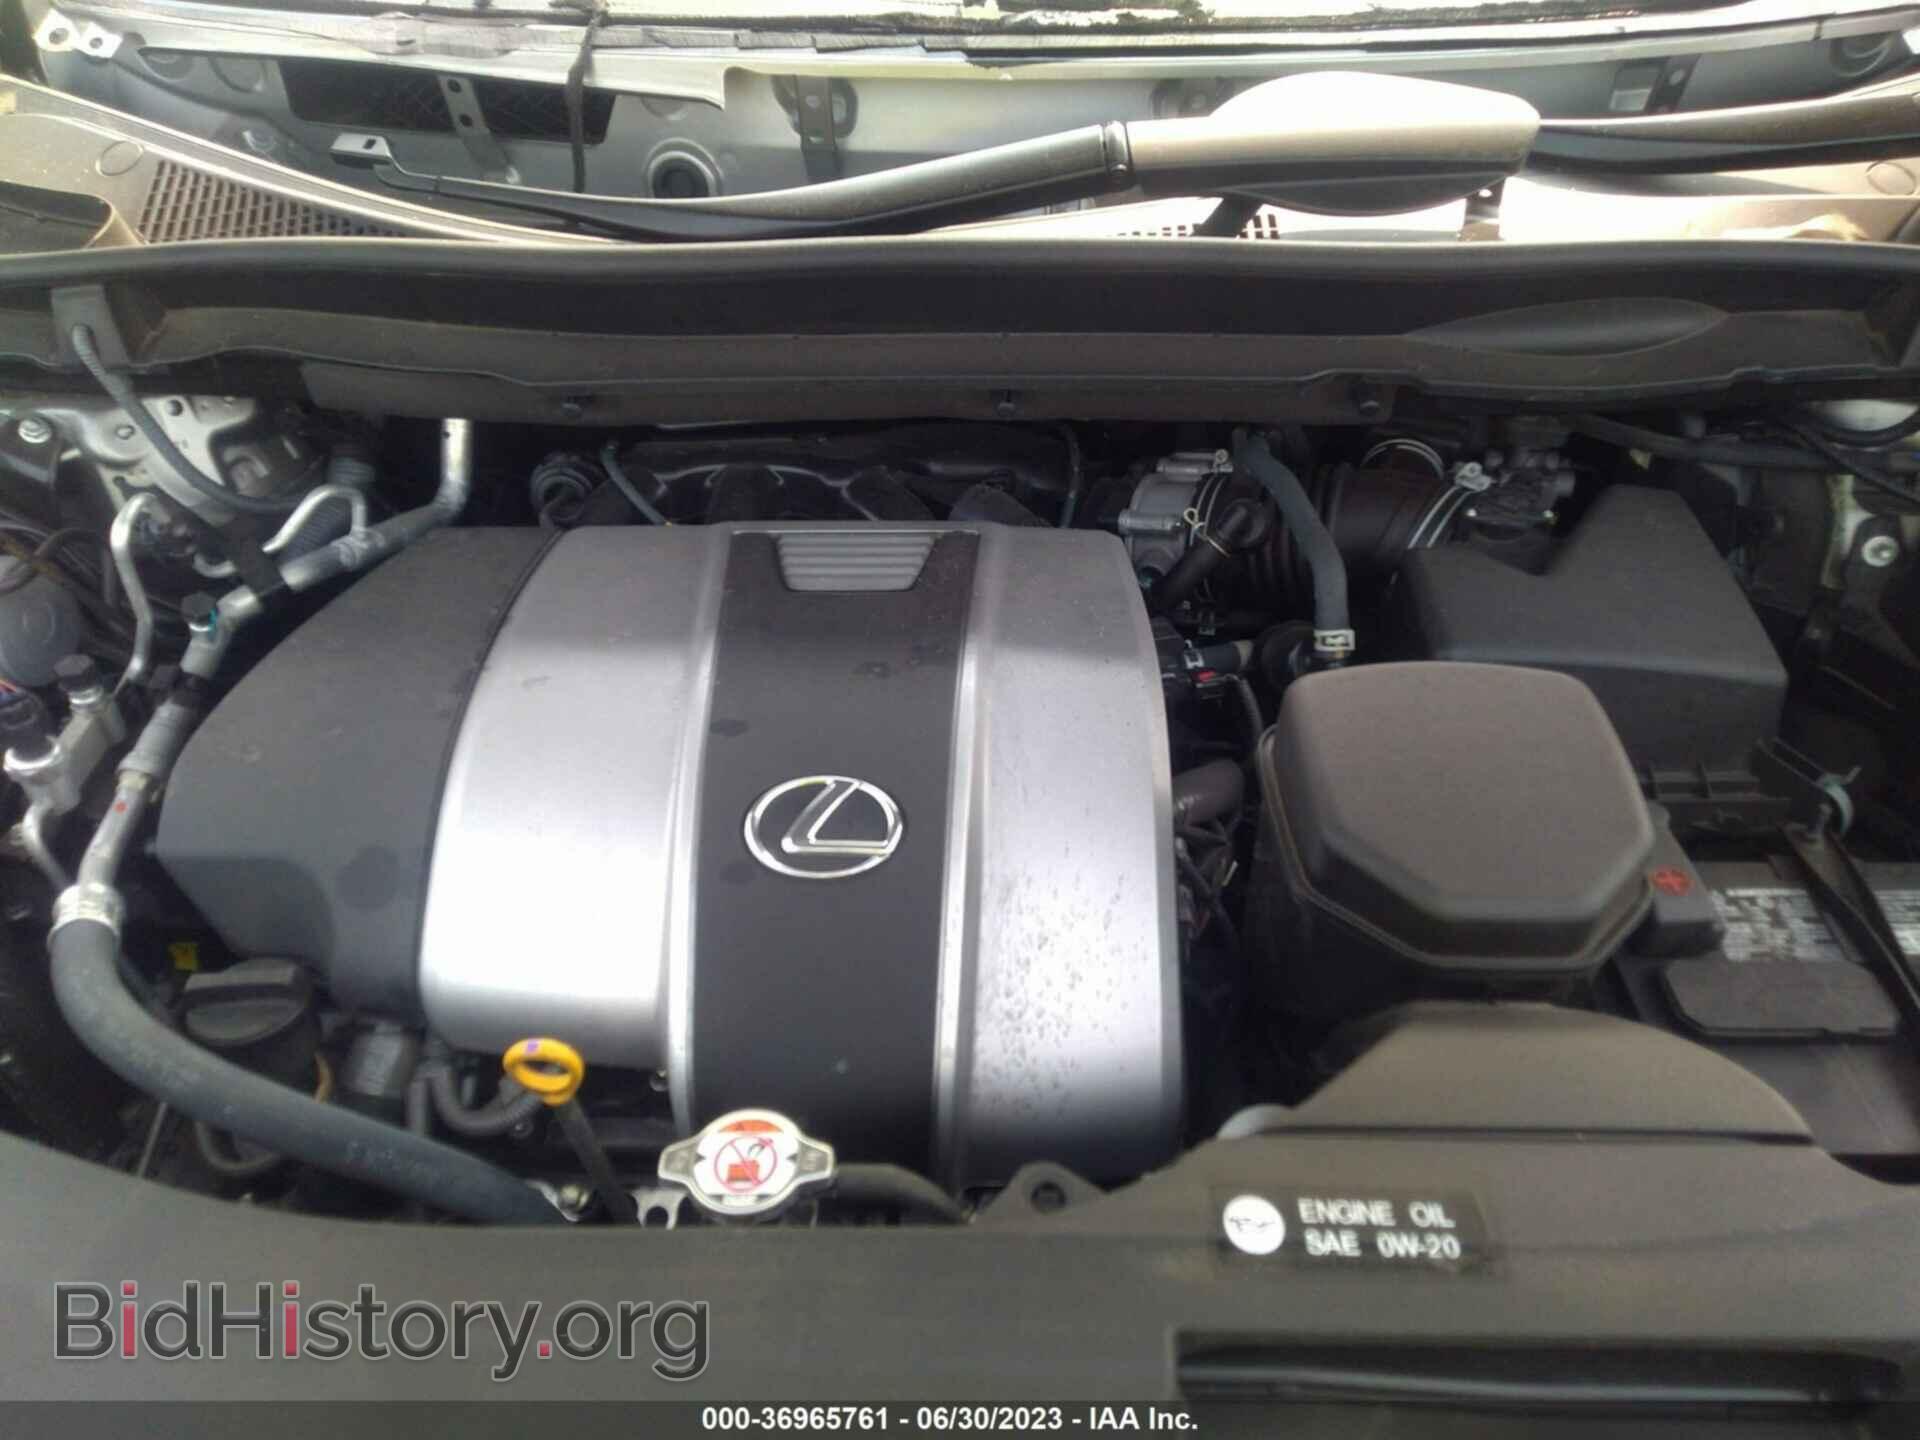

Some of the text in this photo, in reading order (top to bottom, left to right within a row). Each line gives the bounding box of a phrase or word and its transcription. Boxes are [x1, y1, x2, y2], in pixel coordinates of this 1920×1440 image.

[1298, 1197, 1456, 1229] ENGINE OIL
[1305, 1228, 1462, 1260] SAE 0W-20
